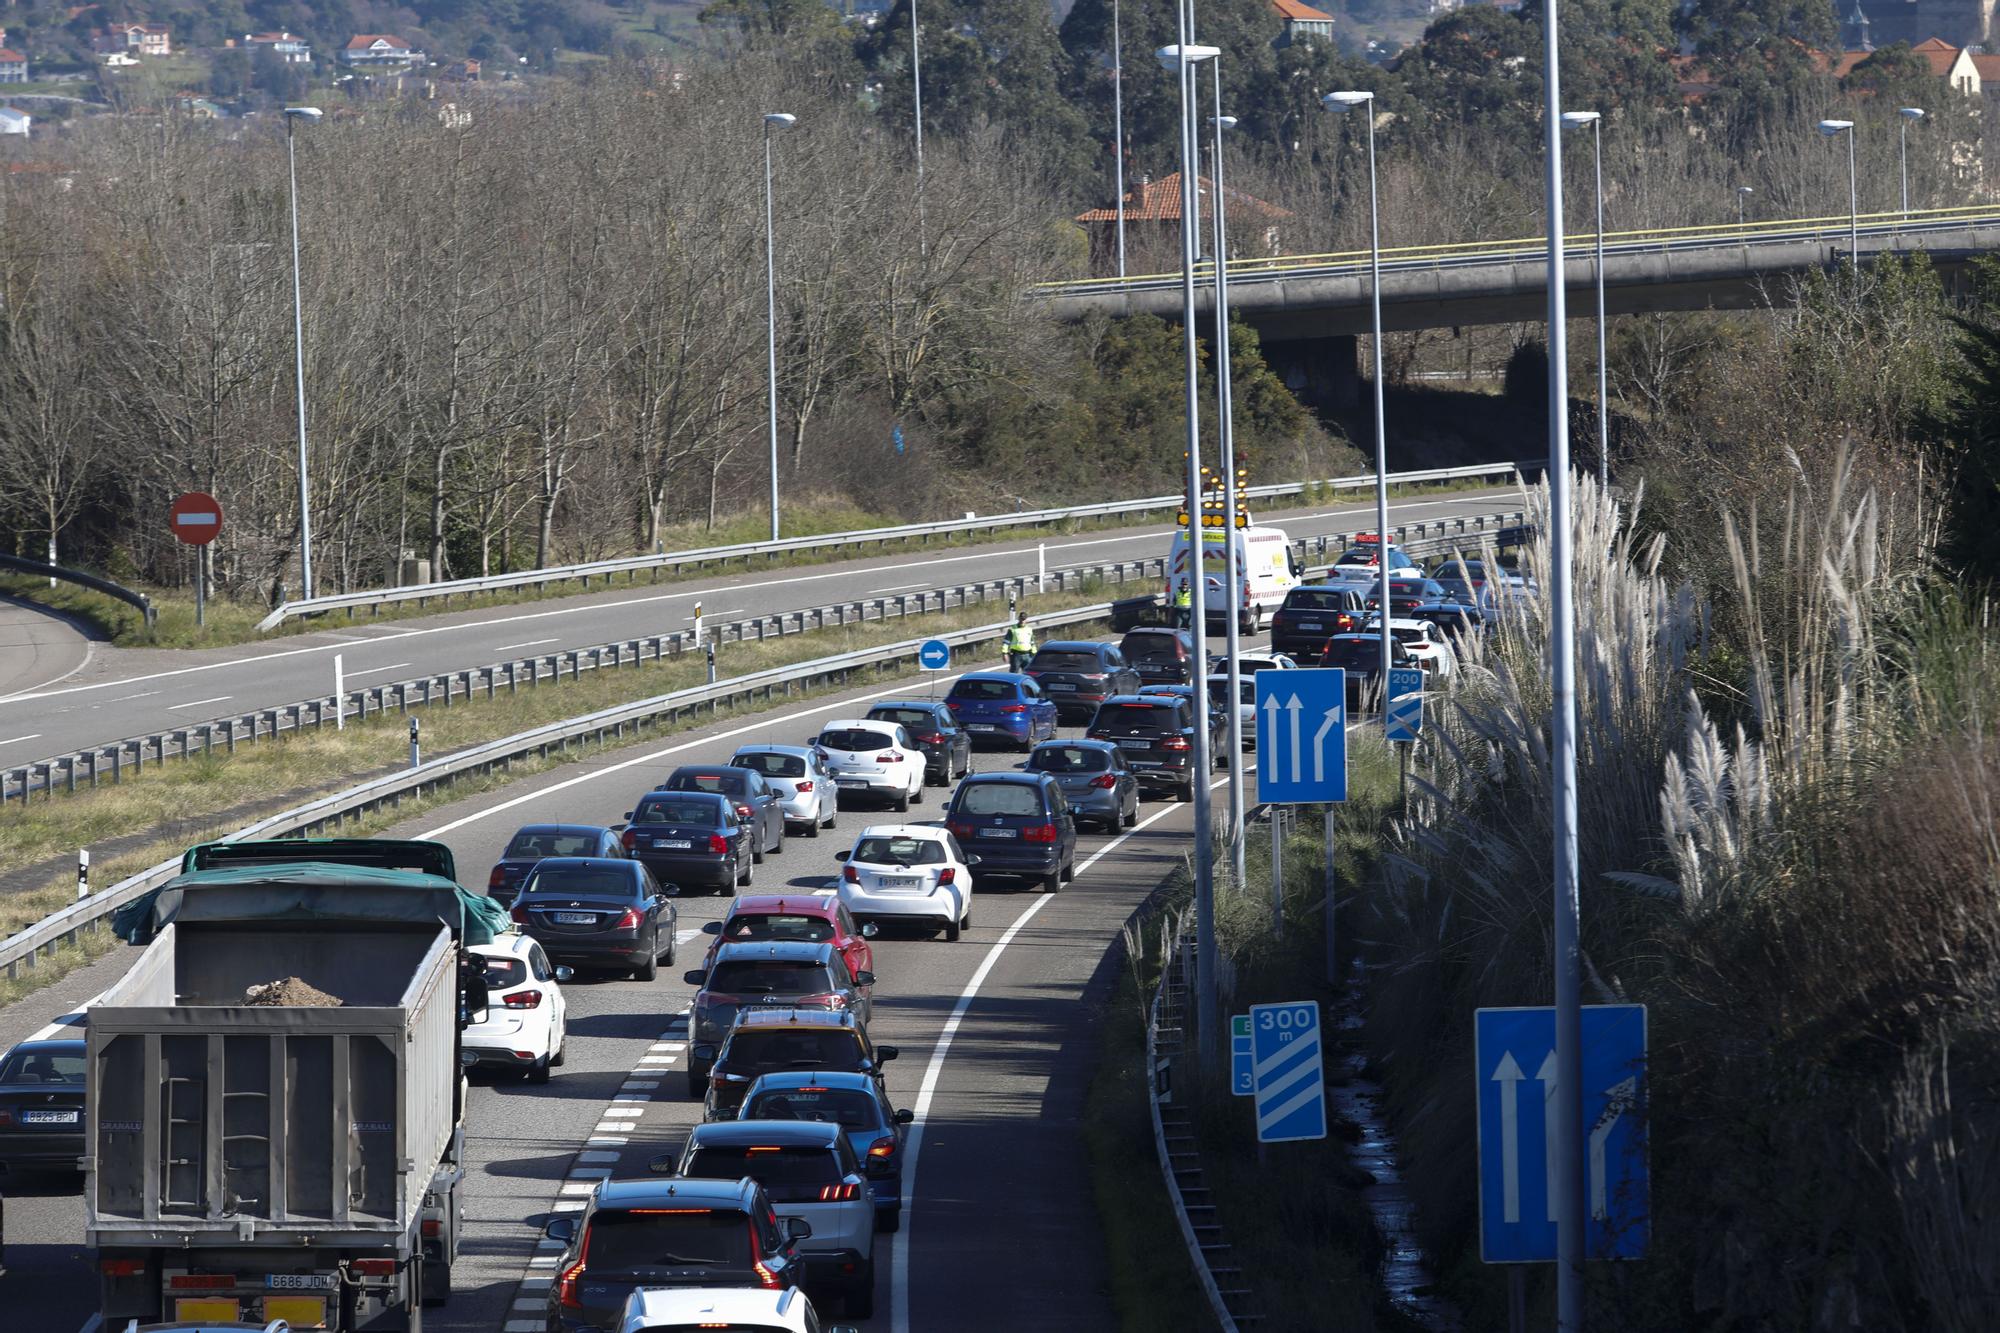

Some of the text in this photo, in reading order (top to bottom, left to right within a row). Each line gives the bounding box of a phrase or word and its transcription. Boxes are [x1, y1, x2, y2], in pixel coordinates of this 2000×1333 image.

[1392, 673, 1419, 684] 200
[1260, 1009, 1310, 1030] 300
[1279, 1031, 1293, 1042] m
[272, 1276, 329, 1288] 6686 JDM
